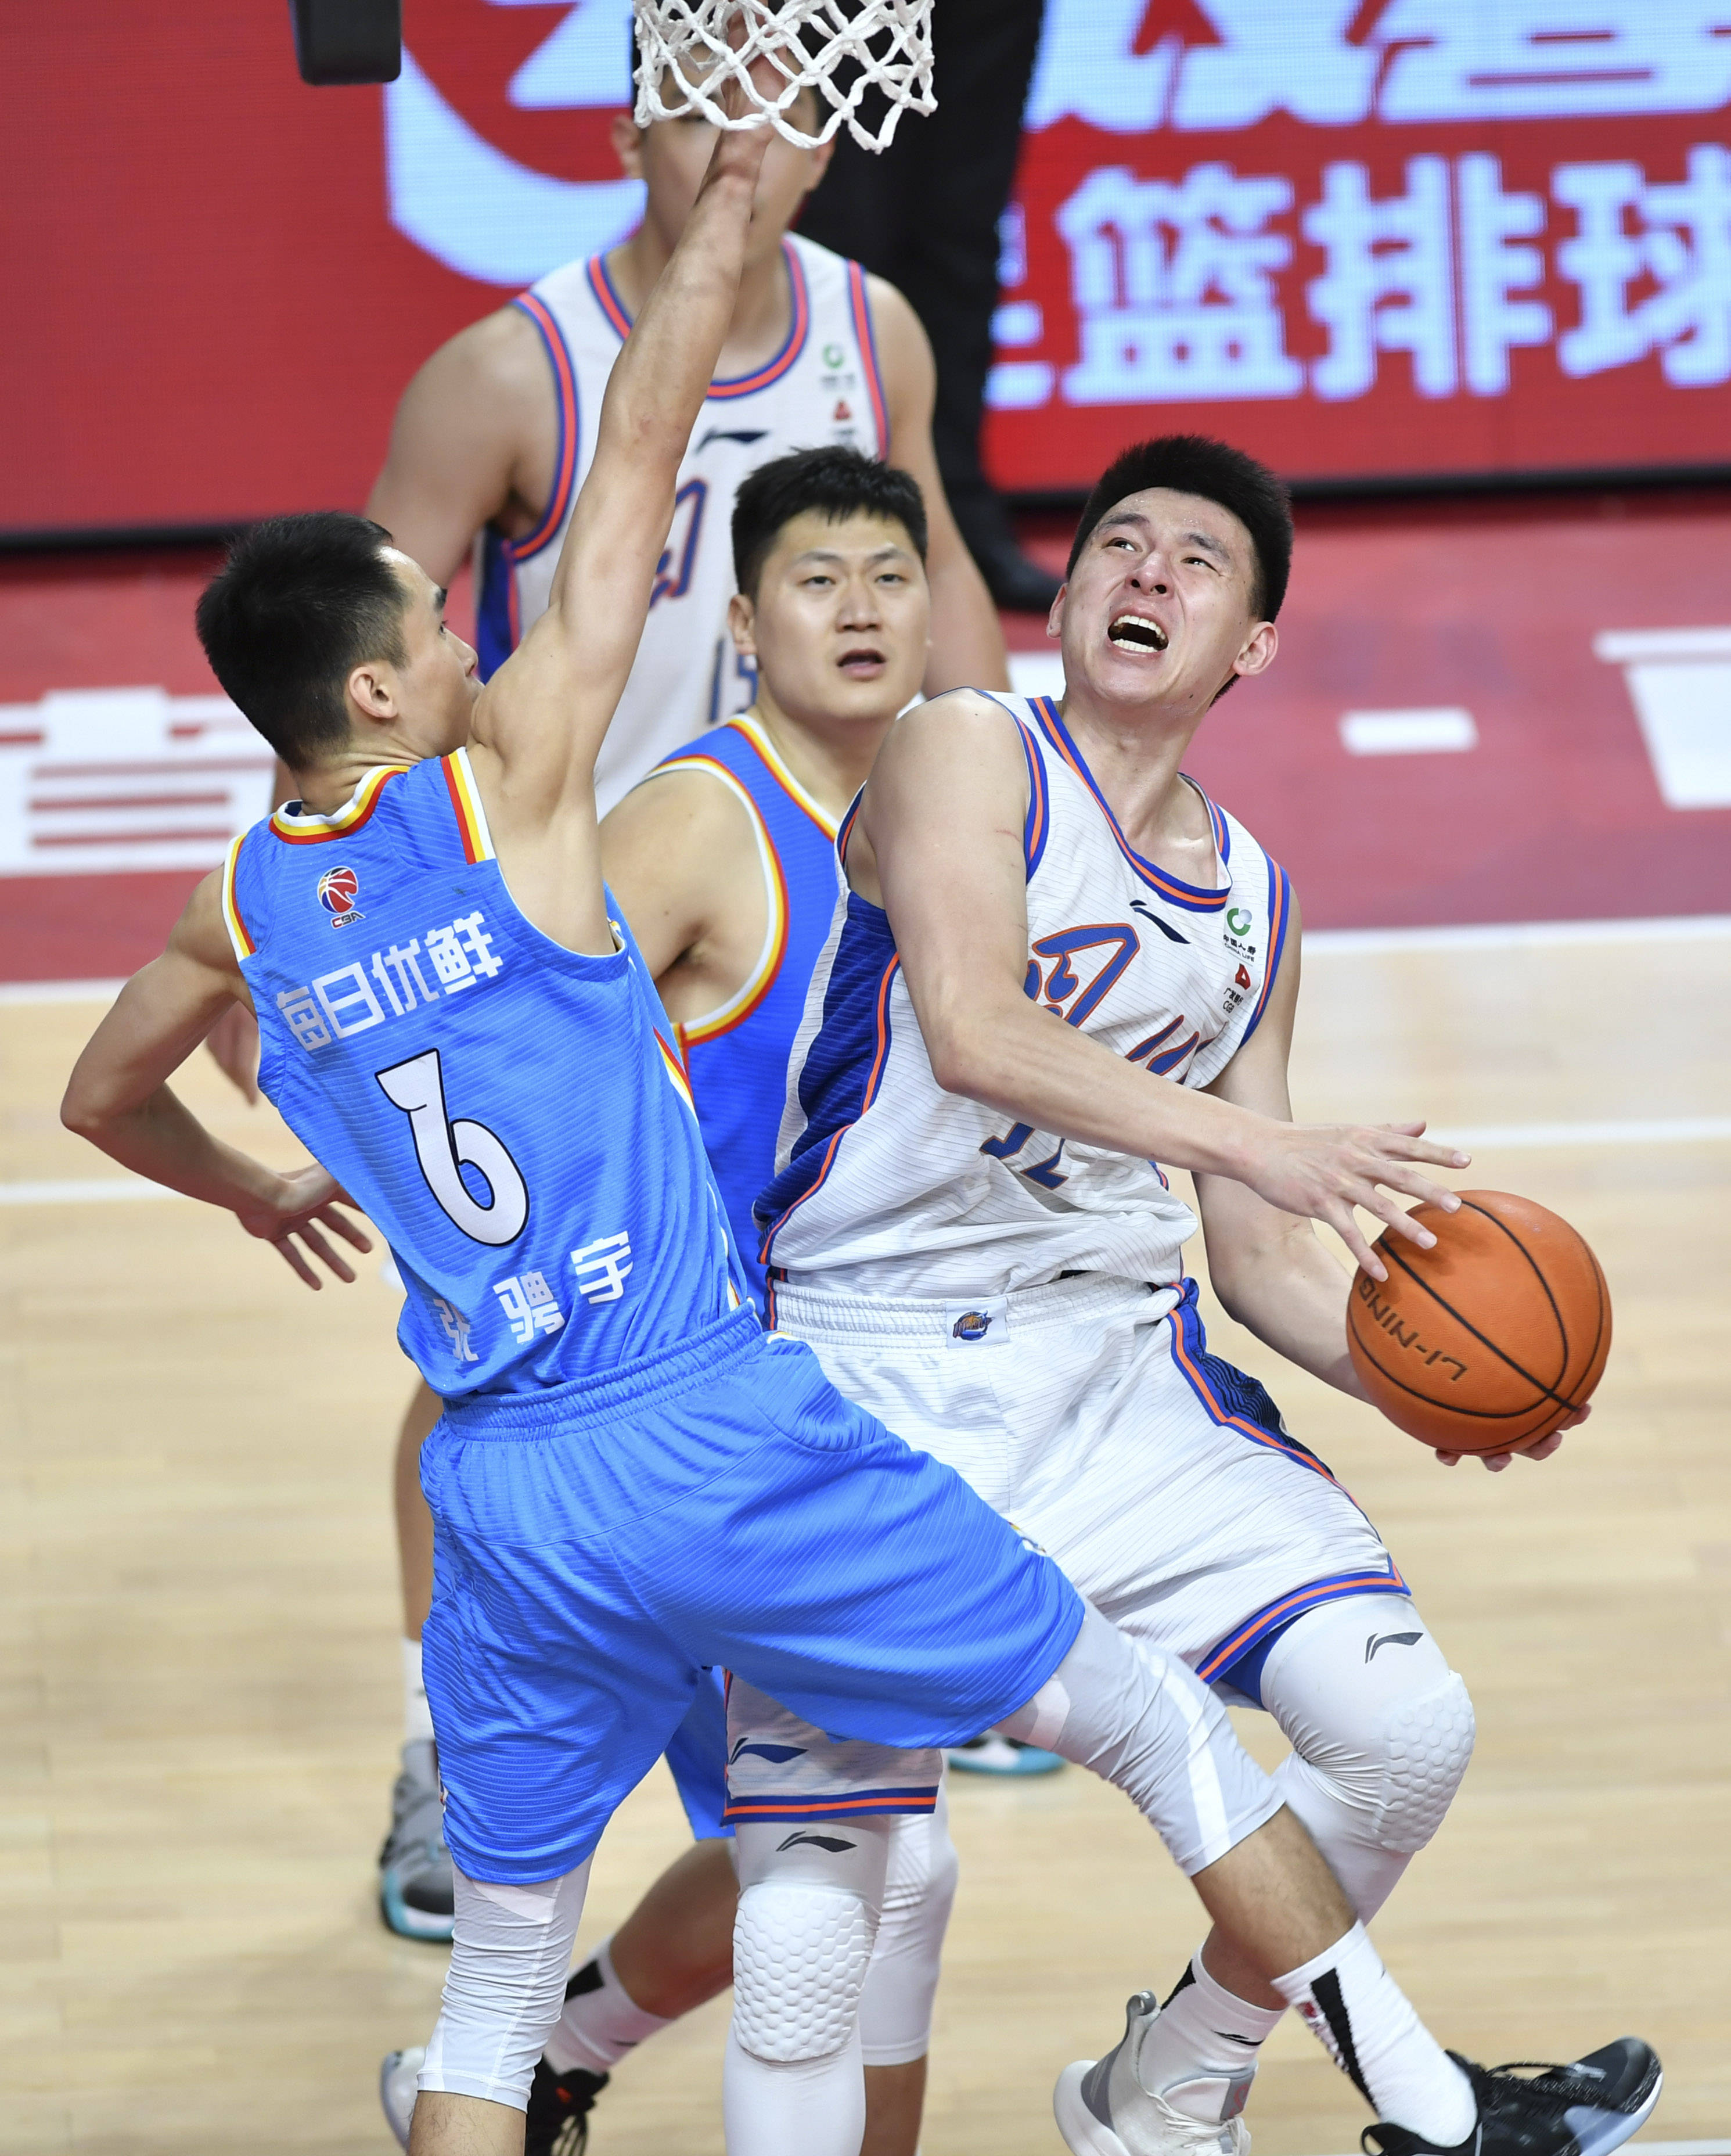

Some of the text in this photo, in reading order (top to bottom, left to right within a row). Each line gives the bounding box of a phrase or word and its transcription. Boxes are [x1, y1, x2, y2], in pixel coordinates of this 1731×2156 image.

[984, 143, 1731, 409] 篮排球
[330, 910, 366, 929] CBA
[1223, 933, 1257, 955] 中国人寿
[1242, 952, 1255, 962] LIFE
[276, 911, 503, 1052] 每日优鲜
[375, 1047, 530, 1247] 6
[1358, 1275, 1469, 1382] LI-NING
